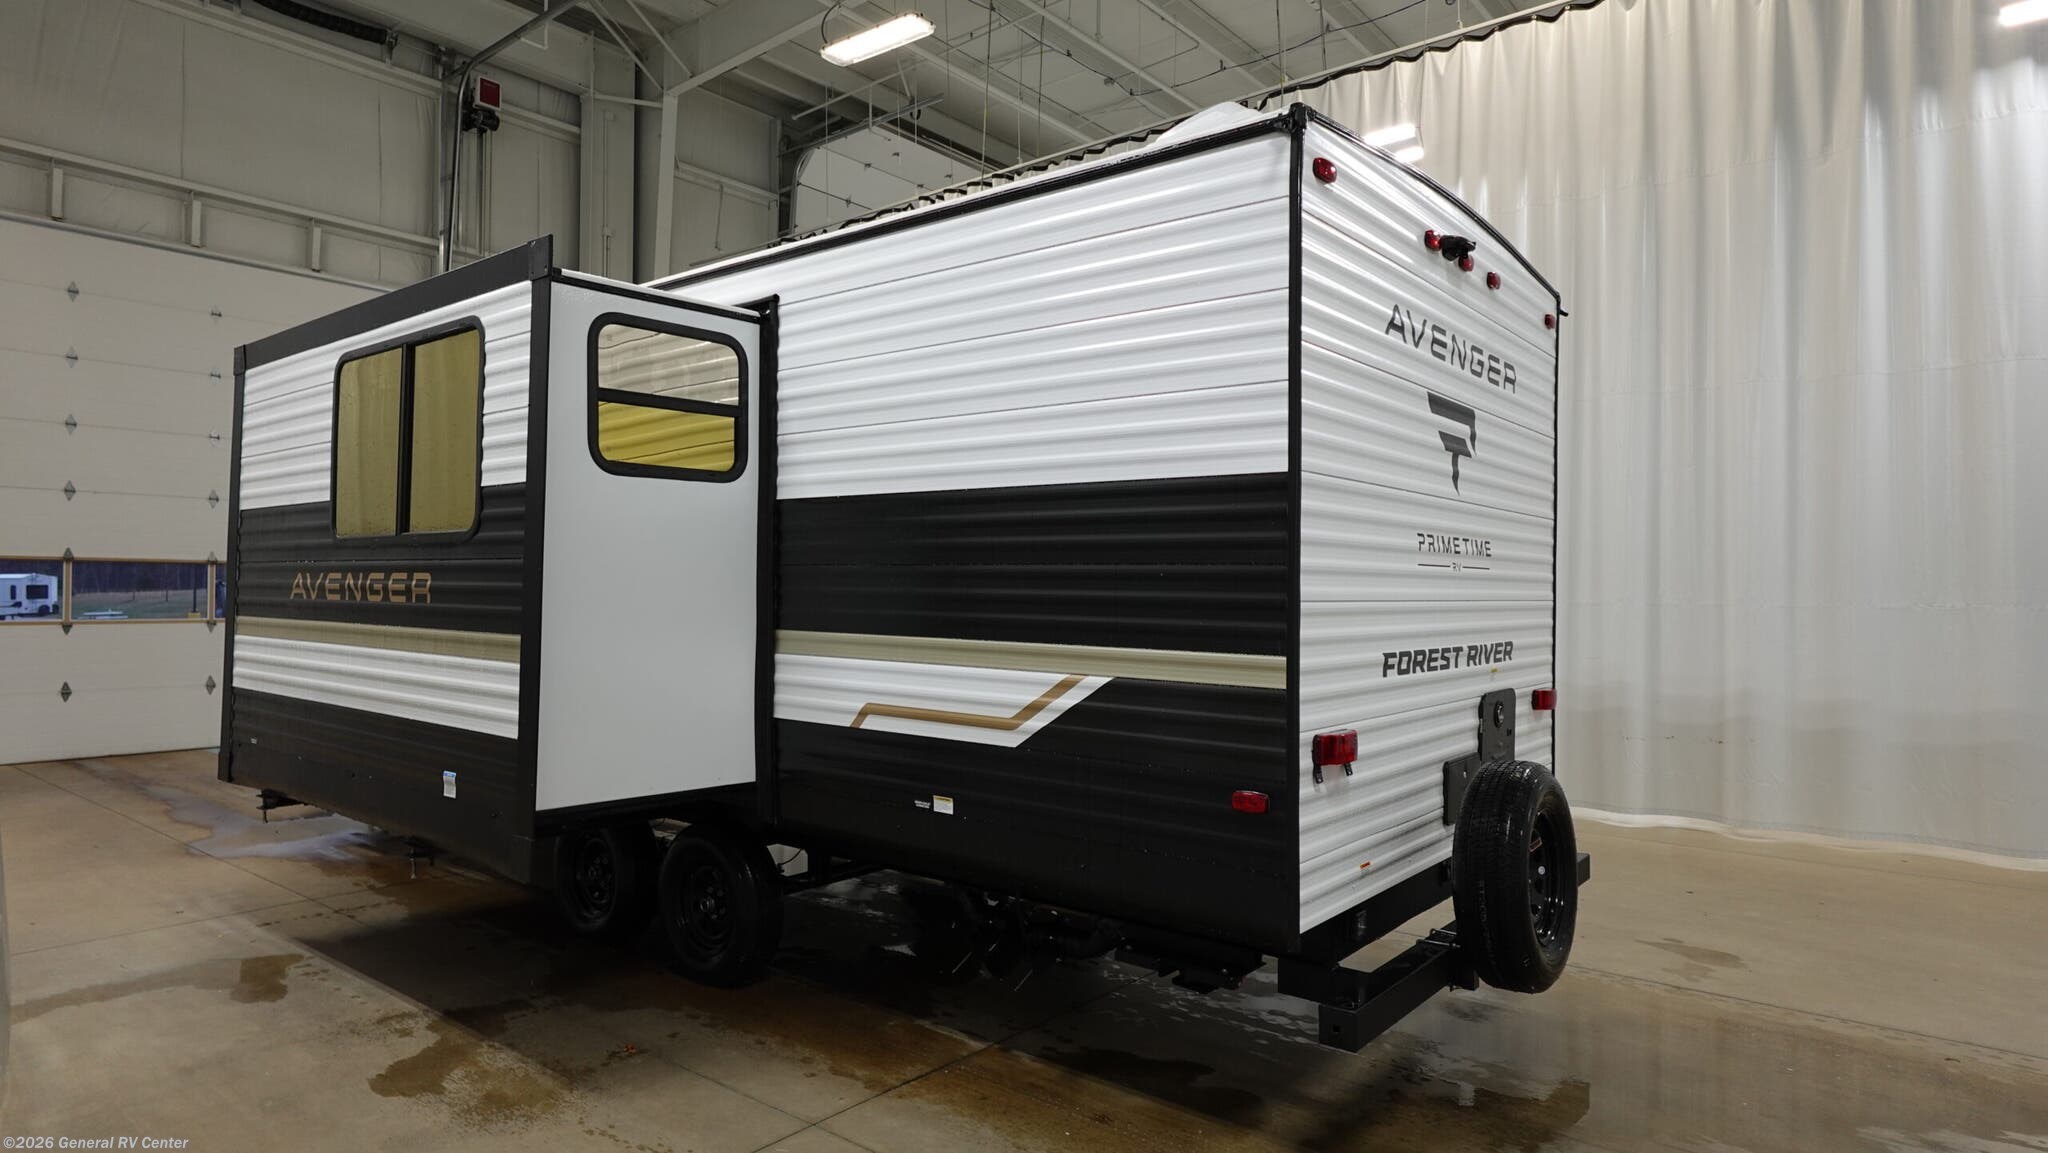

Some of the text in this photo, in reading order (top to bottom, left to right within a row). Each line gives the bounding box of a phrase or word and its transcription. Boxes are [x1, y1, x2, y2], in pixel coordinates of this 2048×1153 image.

[1385, 304, 1516, 394] AVENGER
[290, 572, 432, 604] AVENGER
[1382, 641, 1514, 678] FOREST RIVER
